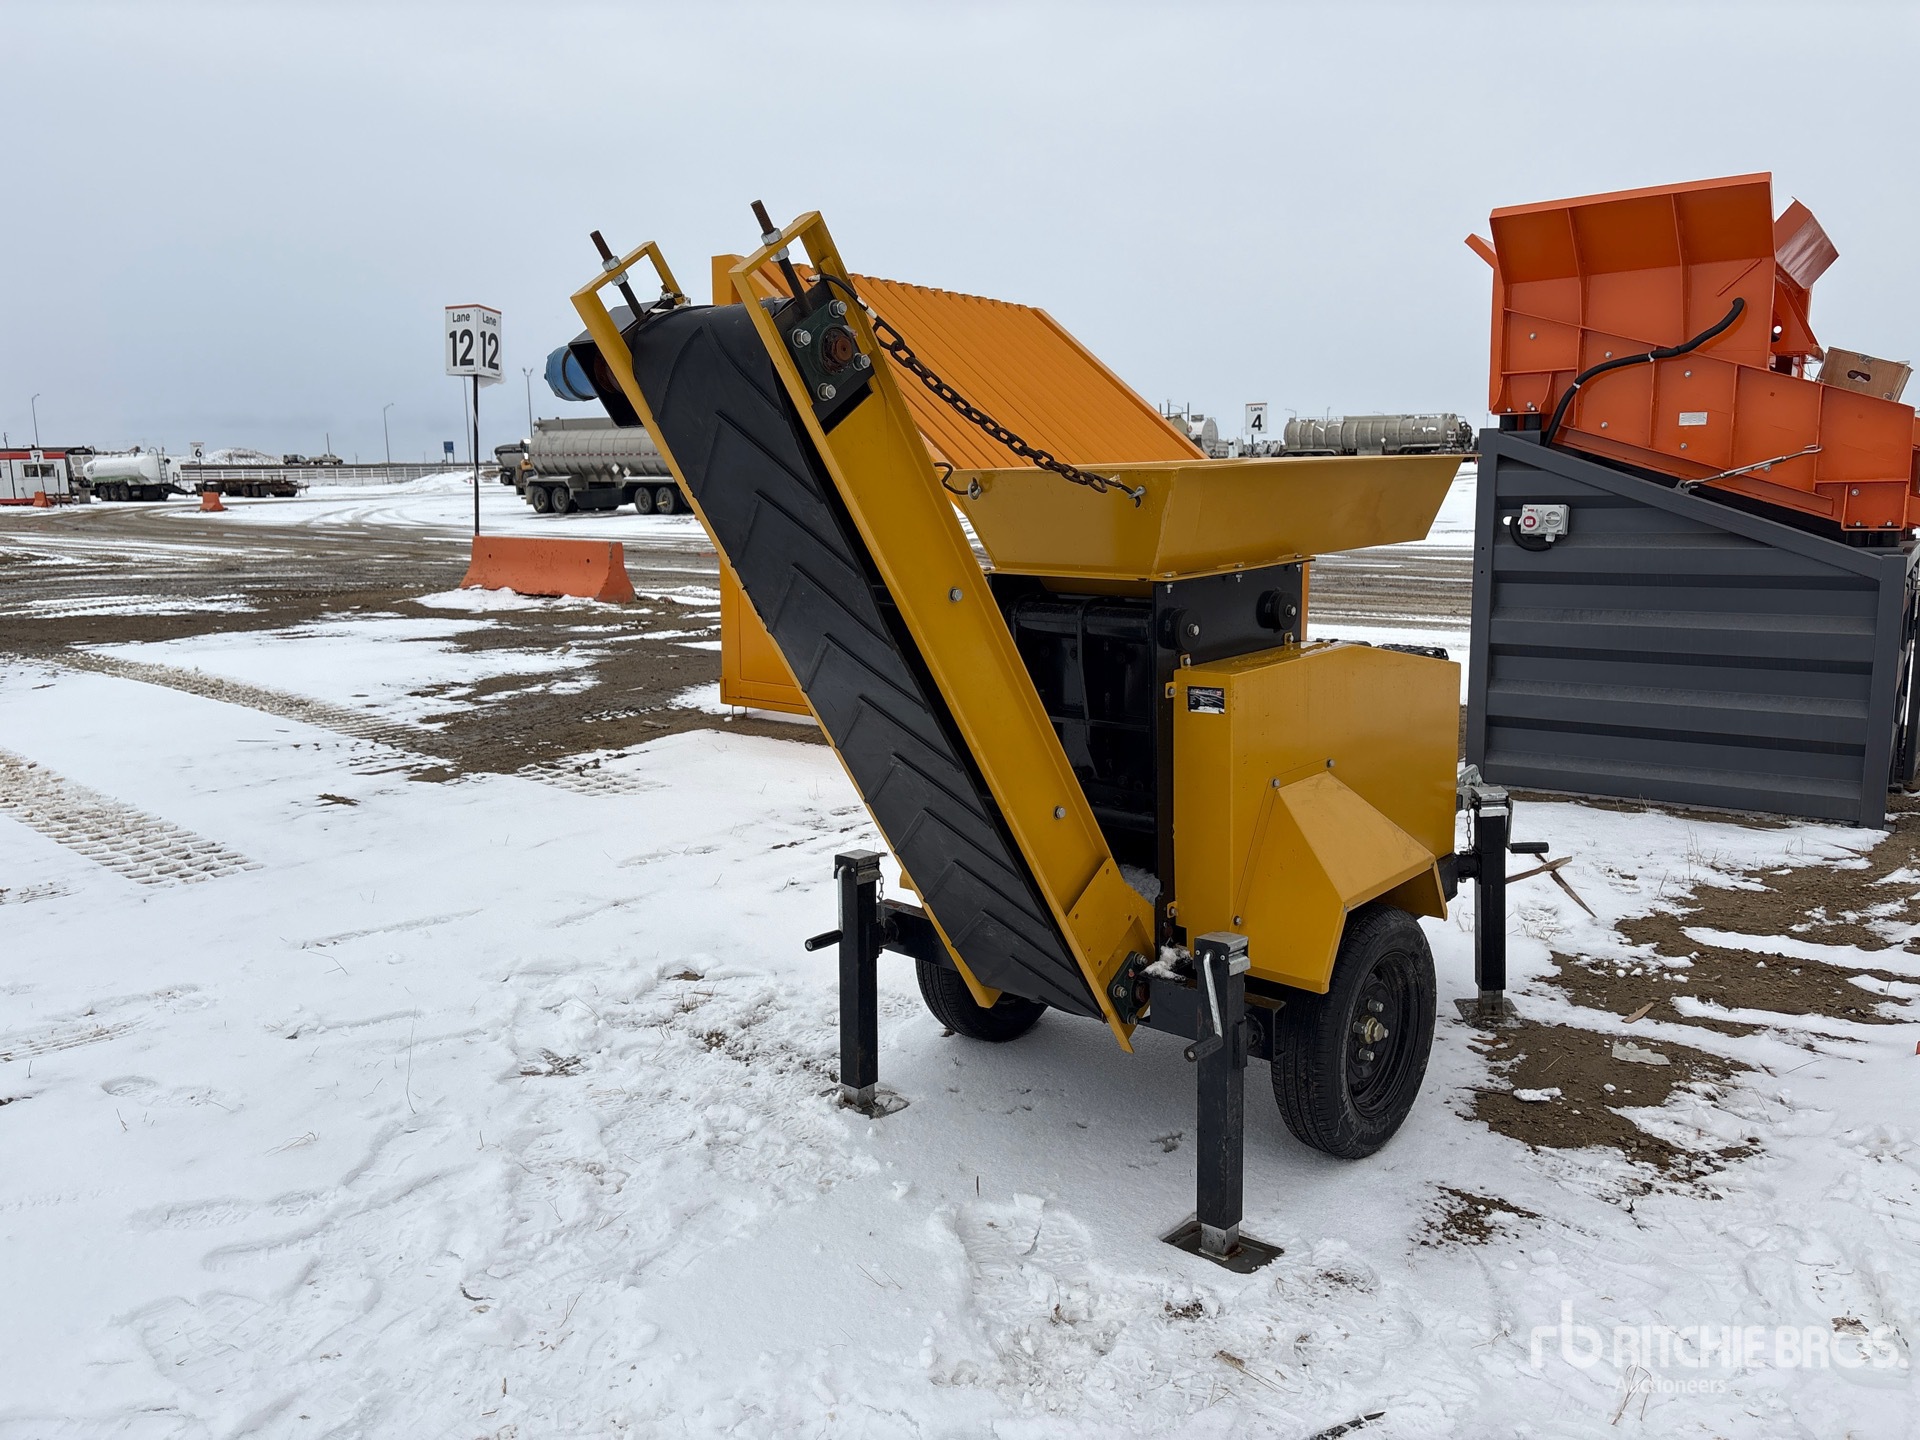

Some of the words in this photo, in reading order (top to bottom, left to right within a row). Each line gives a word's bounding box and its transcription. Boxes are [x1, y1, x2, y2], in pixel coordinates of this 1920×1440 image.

[452, 312, 471, 323] Lane
[482, 312, 497, 327] Lane
[449, 328, 474, 367] 12
[480, 330, 499, 371] 12
[1251, 413, 1263, 431] 4
[33, 455, 41, 463] 7
[195, 448, 202, 458] 6
